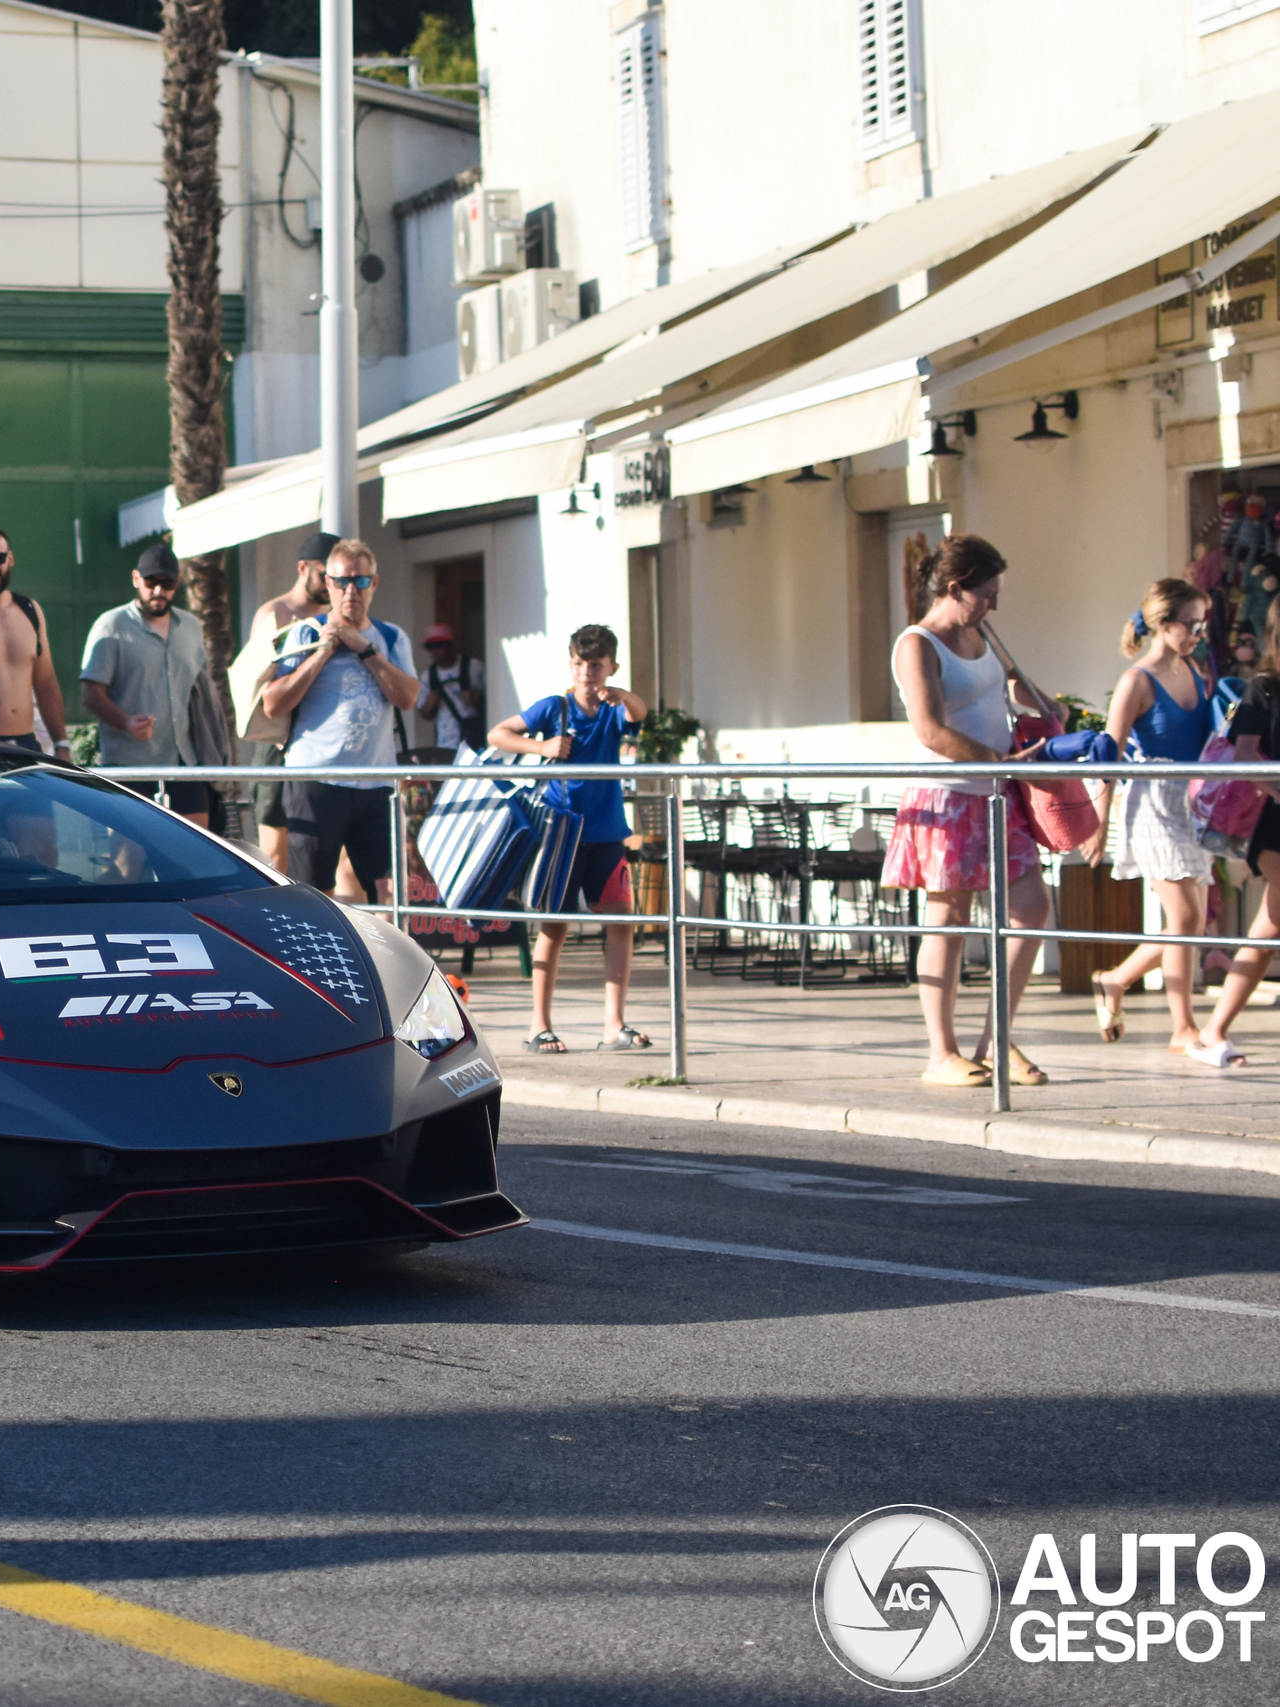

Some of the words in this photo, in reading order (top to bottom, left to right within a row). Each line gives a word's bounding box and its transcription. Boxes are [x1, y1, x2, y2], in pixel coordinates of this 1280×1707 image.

[64, 1015, 125, 1028] AUTO
[136, 1011, 206, 1024] SPORT
[445, 1062, 496, 1094] MOTUL
